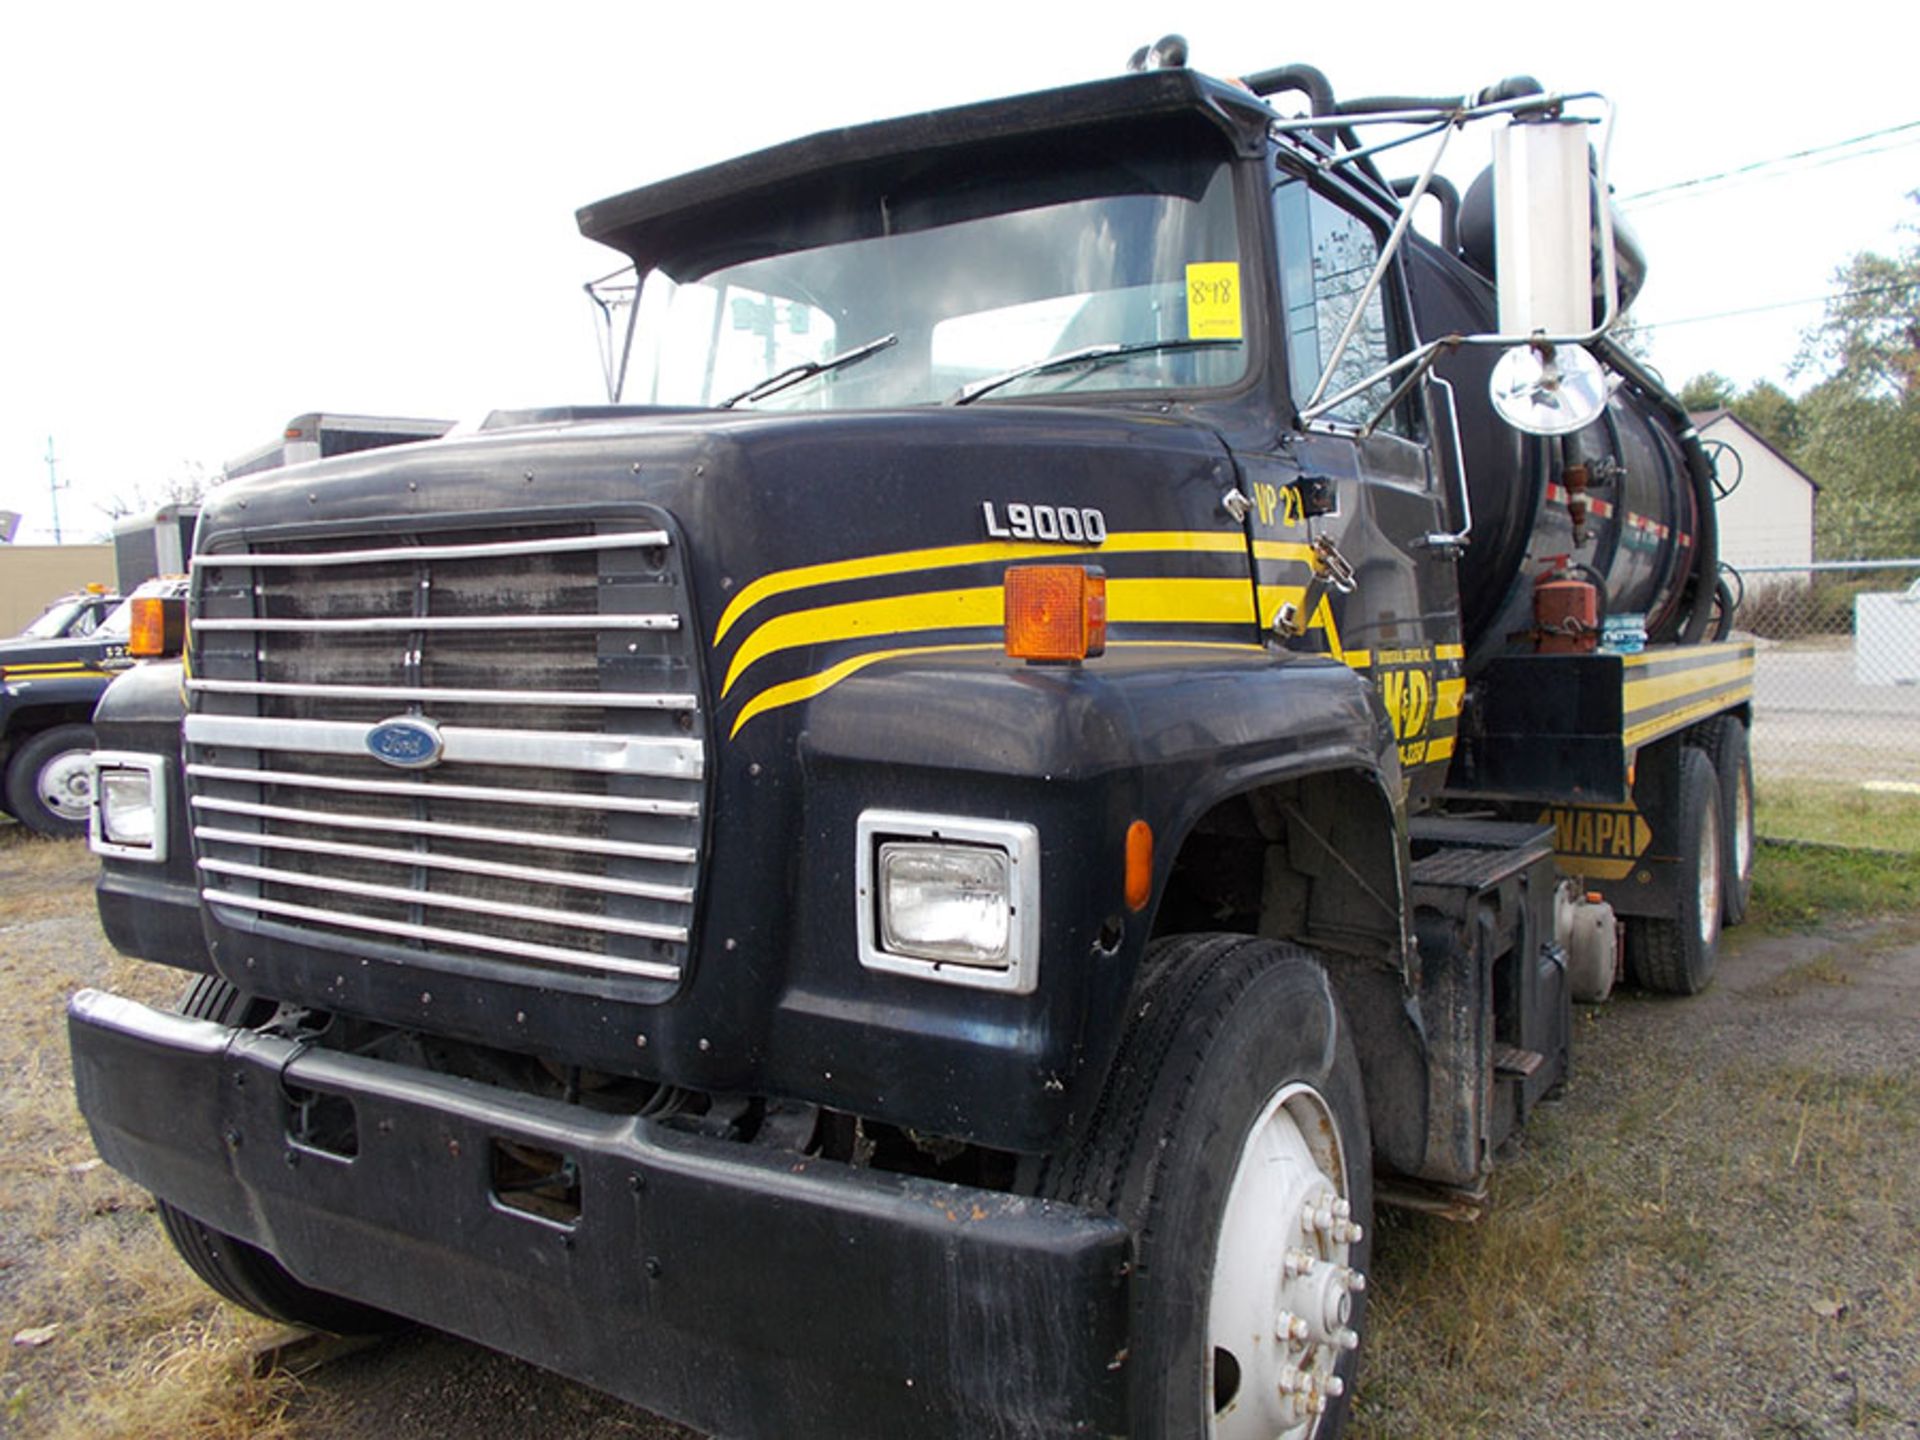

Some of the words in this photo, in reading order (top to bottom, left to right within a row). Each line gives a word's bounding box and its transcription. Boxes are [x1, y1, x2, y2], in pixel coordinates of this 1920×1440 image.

[983, 501, 1107, 543] L9000
[381, 727, 423, 755] Ford
[1553, 811, 1633, 857] NAPA
